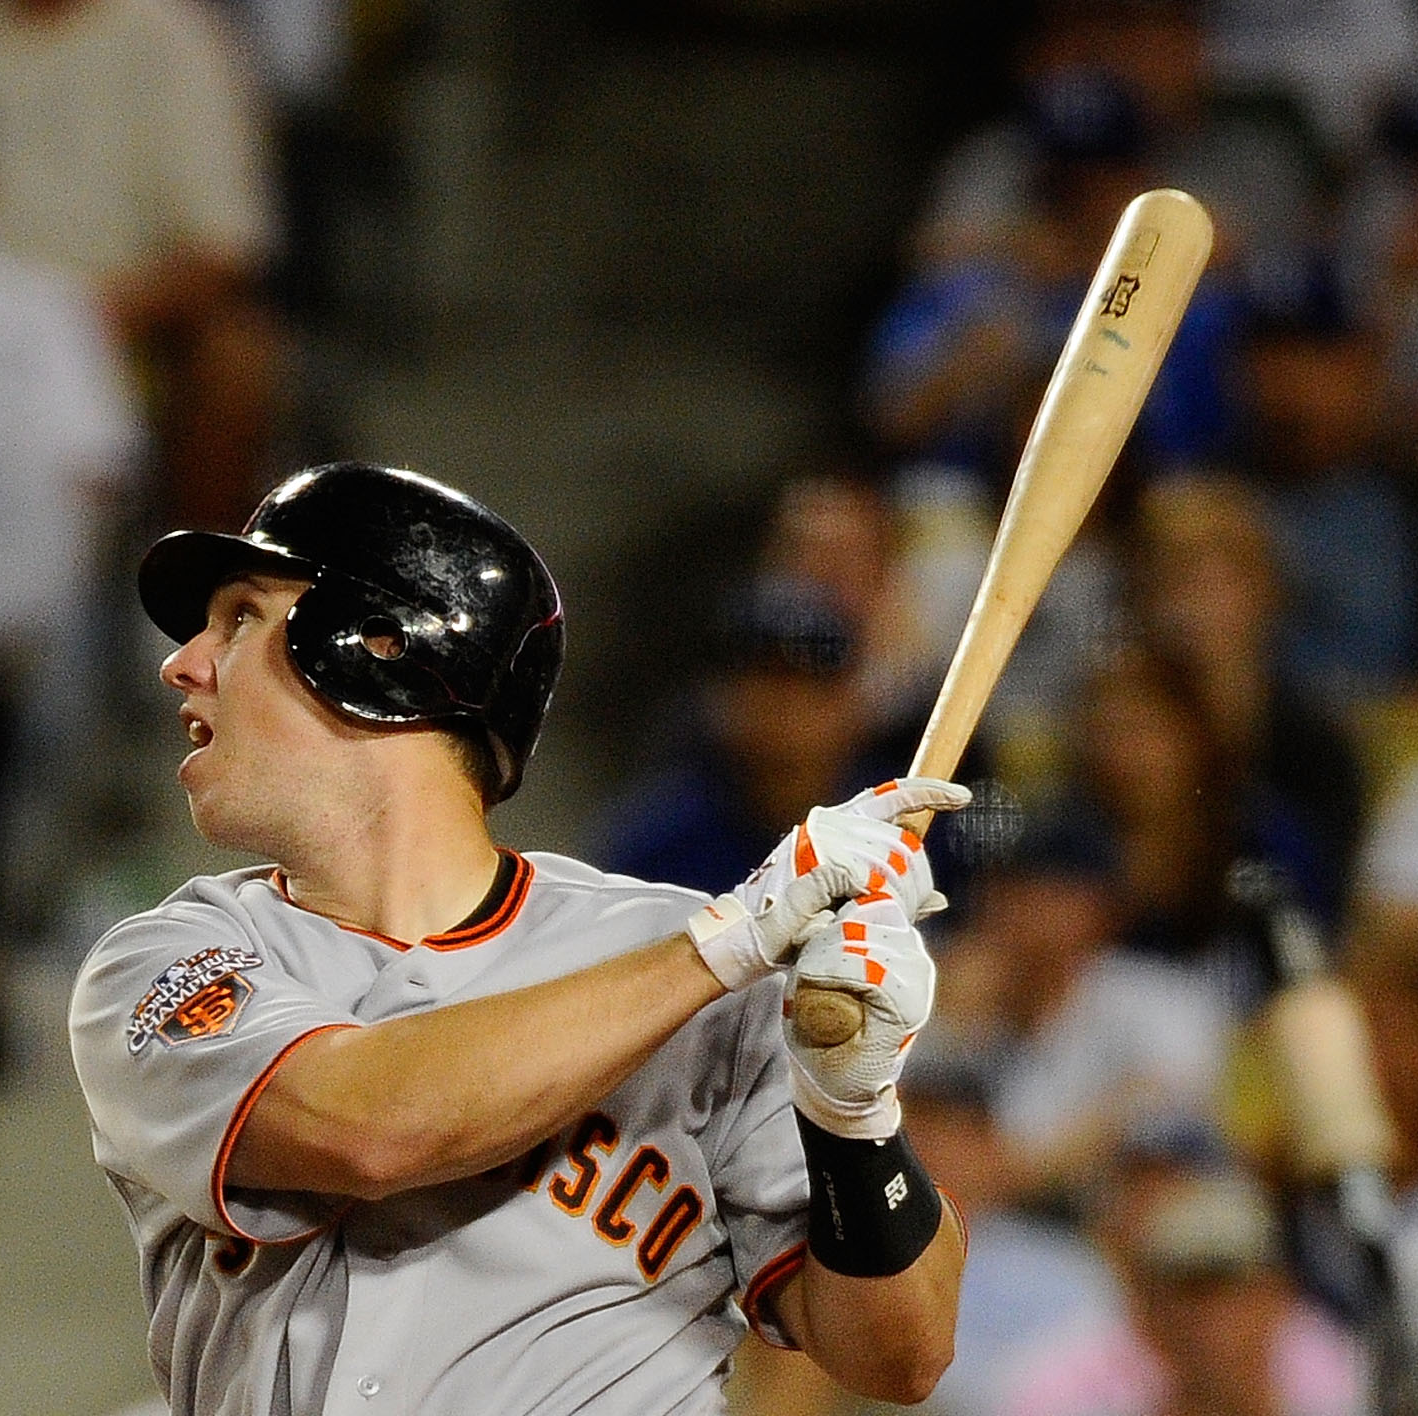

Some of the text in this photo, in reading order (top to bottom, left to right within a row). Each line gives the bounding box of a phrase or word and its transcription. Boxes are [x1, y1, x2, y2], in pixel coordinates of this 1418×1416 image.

[128, 977, 188, 1034] WORLD
[129, 955, 263, 1052] CHAMPIONS
[884, 1171, 909, 1210] 28
